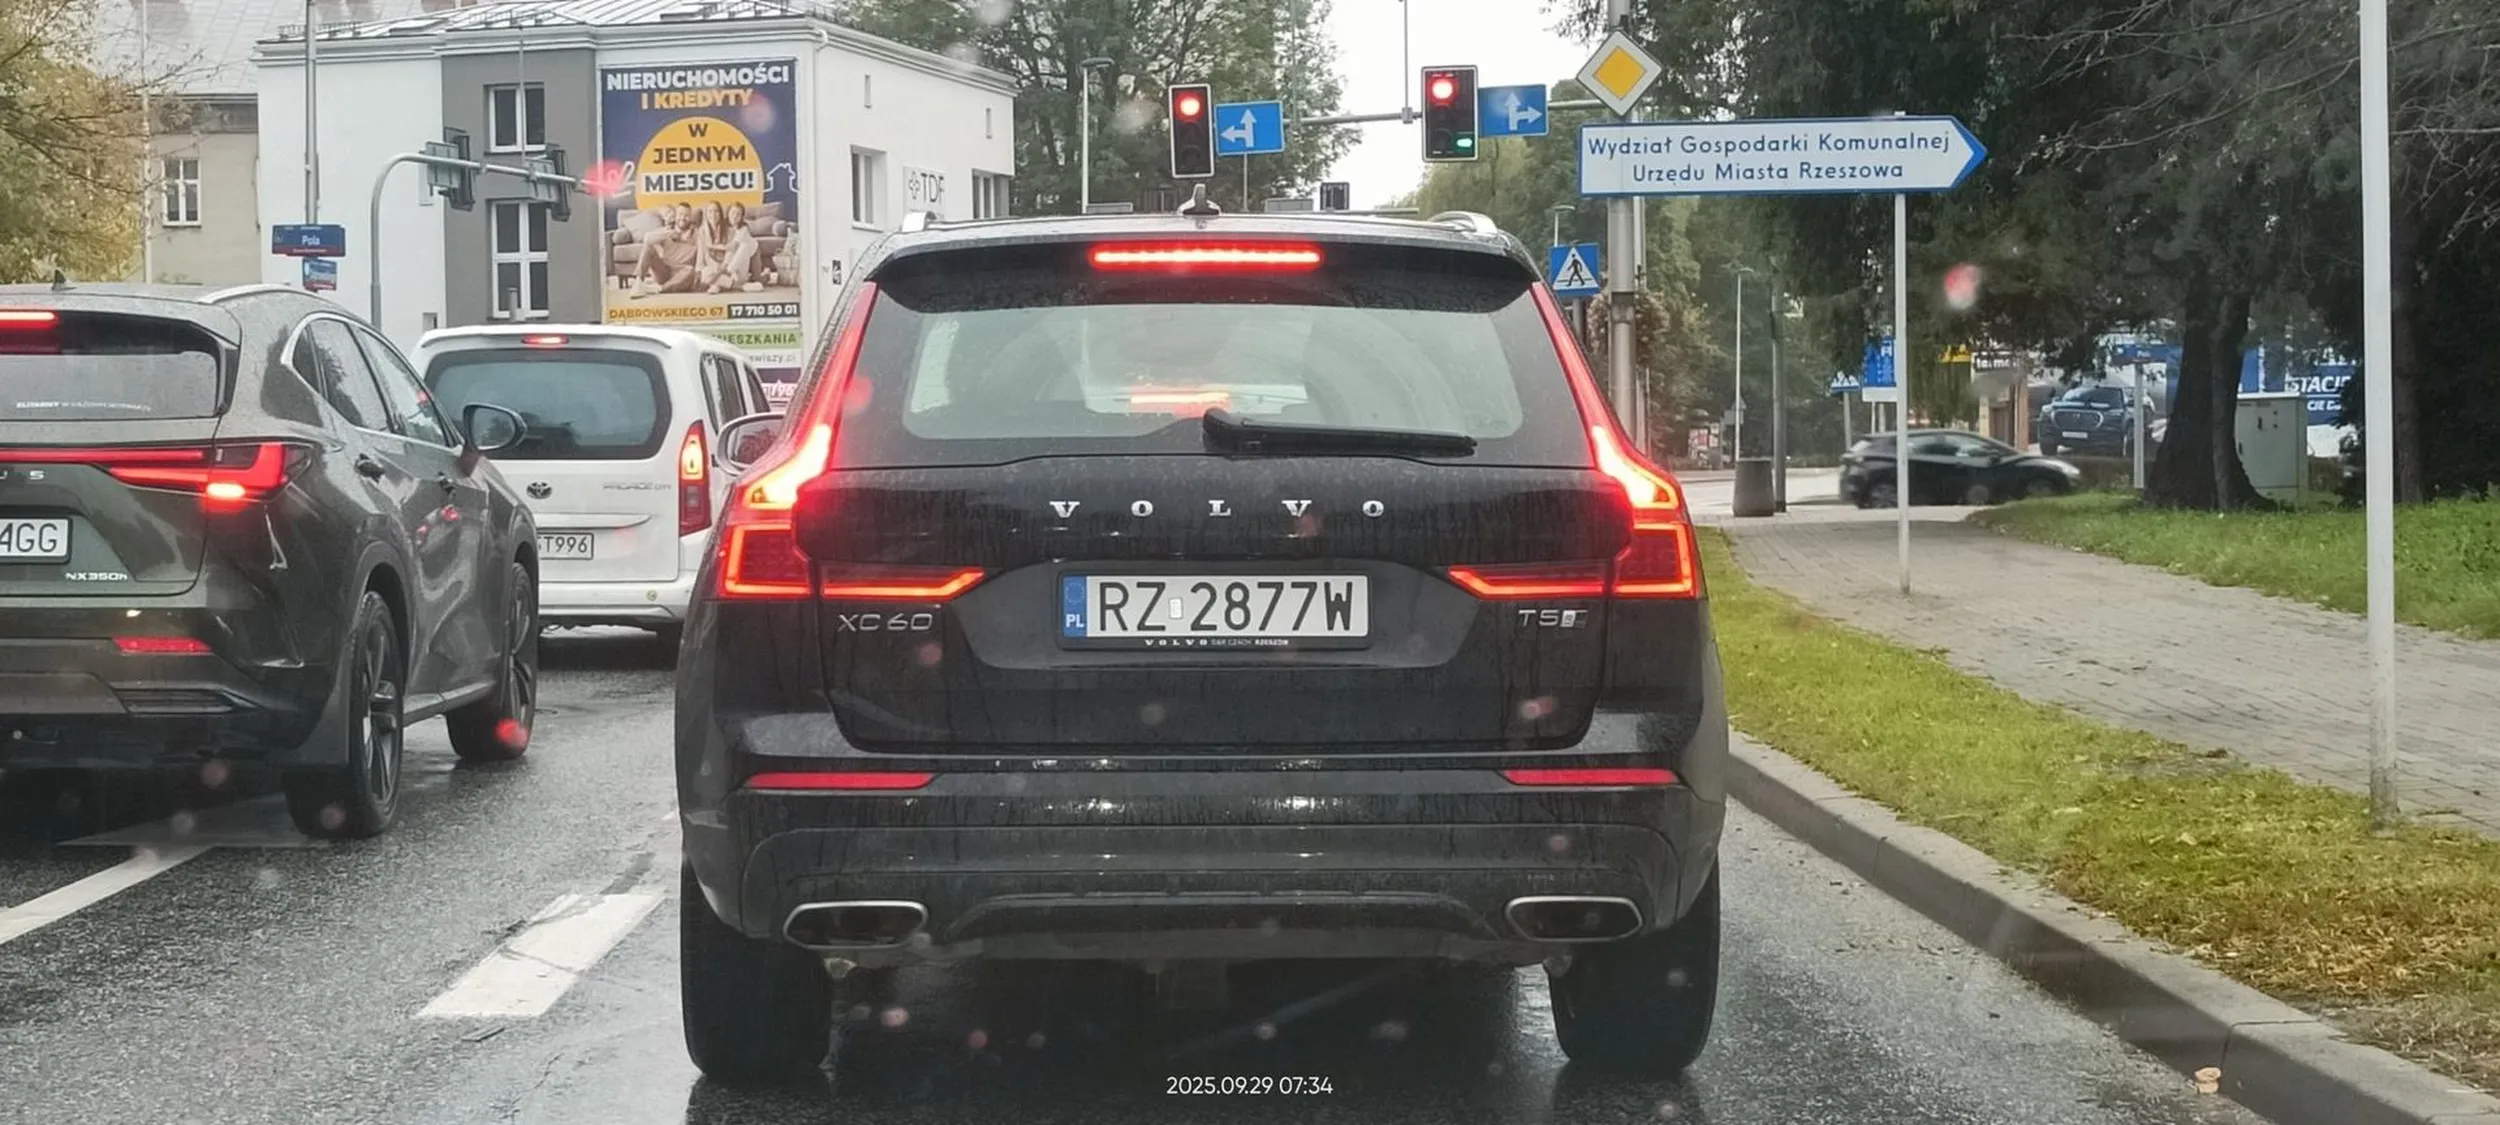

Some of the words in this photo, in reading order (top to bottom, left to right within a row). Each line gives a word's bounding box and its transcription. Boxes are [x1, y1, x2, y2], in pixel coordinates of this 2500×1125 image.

[606, 64, 789, 90] NIERUCHOMOŚCI
[641, 93, 649, 109] I
[654, 89, 753, 109] KREDYTY
[688, 123, 708, 137] W
[653, 145, 746, 164] JEDNYM
[1588, 136, 1672, 160] Wydział
[1680, 134, 1808, 157] Gospodarki
[1819, 131, 1949, 153] Komunalnej
[645, 172, 754, 192] MIEJSCU!
[1633, 164, 1704, 186] Urzędu
[1715, 163, 1788, 180] Miasta
[1800, 162, 1903, 179] Rzeszowa
[709, 306, 724, 317] 67
[730, 305, 743, 316] 17
[745, 305, 765, 316] 710
[767, 304, 783, 315] 50
[784, 304, 798, 314] 01
[1049, 500, 1385, 518] VOLVO
[1099, 581, 1167, 631] RZ
[1189, 581, 1353, 631] 2877W
[1066, 614, 1084, 628] PL
